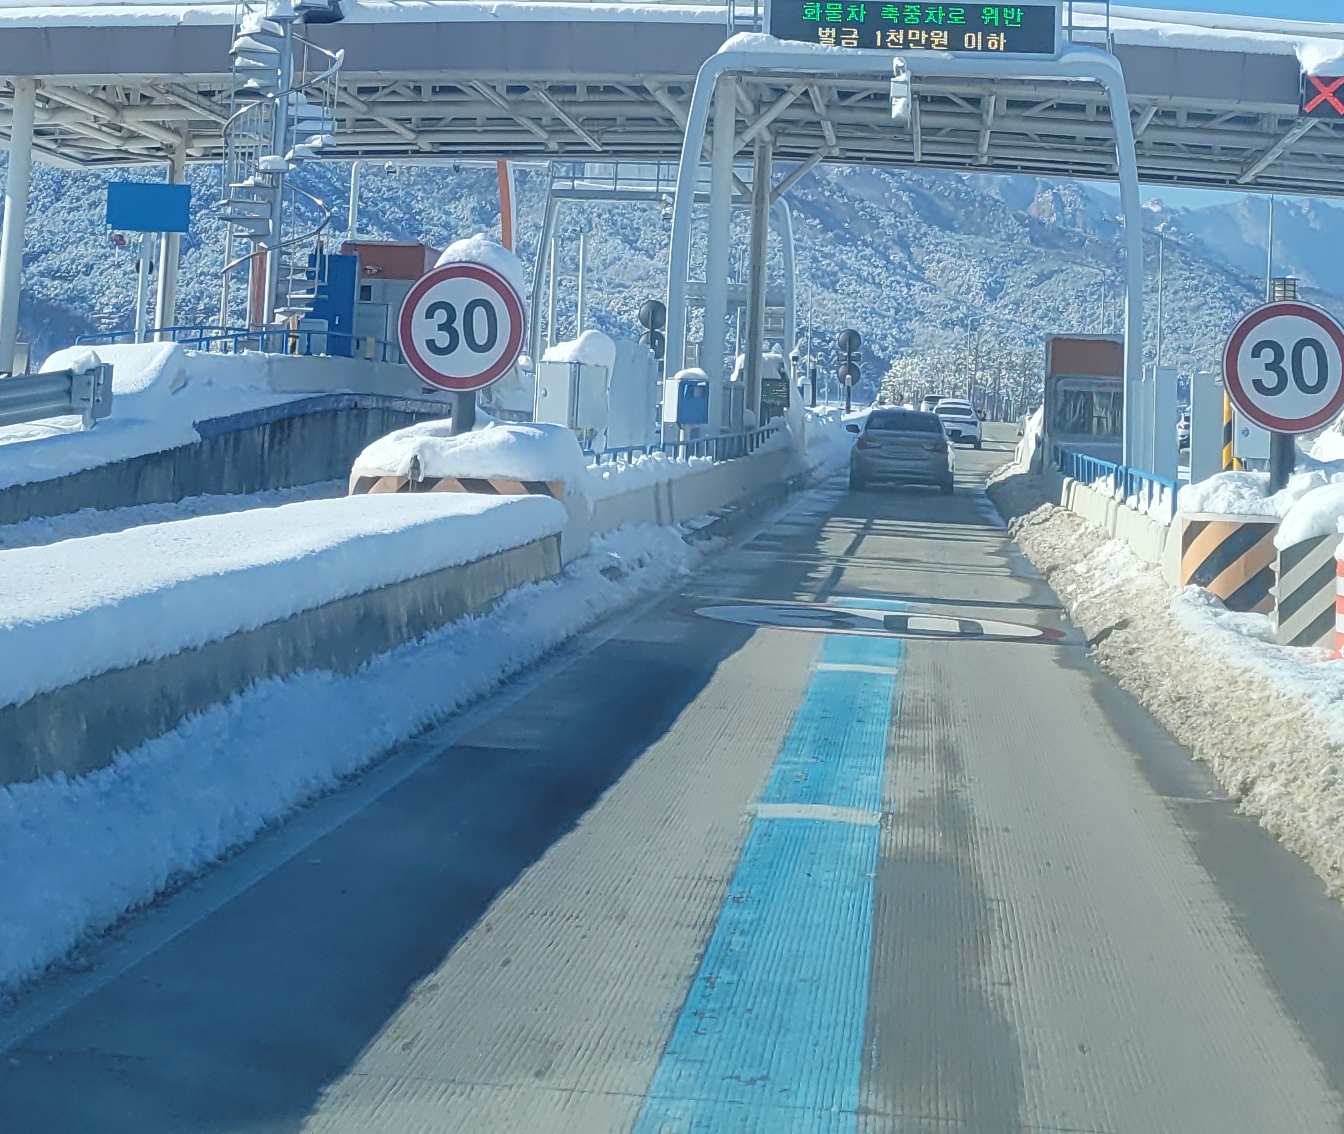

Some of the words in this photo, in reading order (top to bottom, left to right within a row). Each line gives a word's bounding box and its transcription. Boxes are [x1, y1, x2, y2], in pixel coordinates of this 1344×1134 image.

[802, 2, 867, 23] 화물차
[881, 4, 966, 24] 축중차로
[980, 7, 1024, 27] 위반
[818, 27, 859, 47] 벌금
[876, 29, 948, 50] 1천만원
[964, 31, 1007, 52] 이하
[424, 298, 498, 356] 30
[1250, 337, 1329, 397] 30
